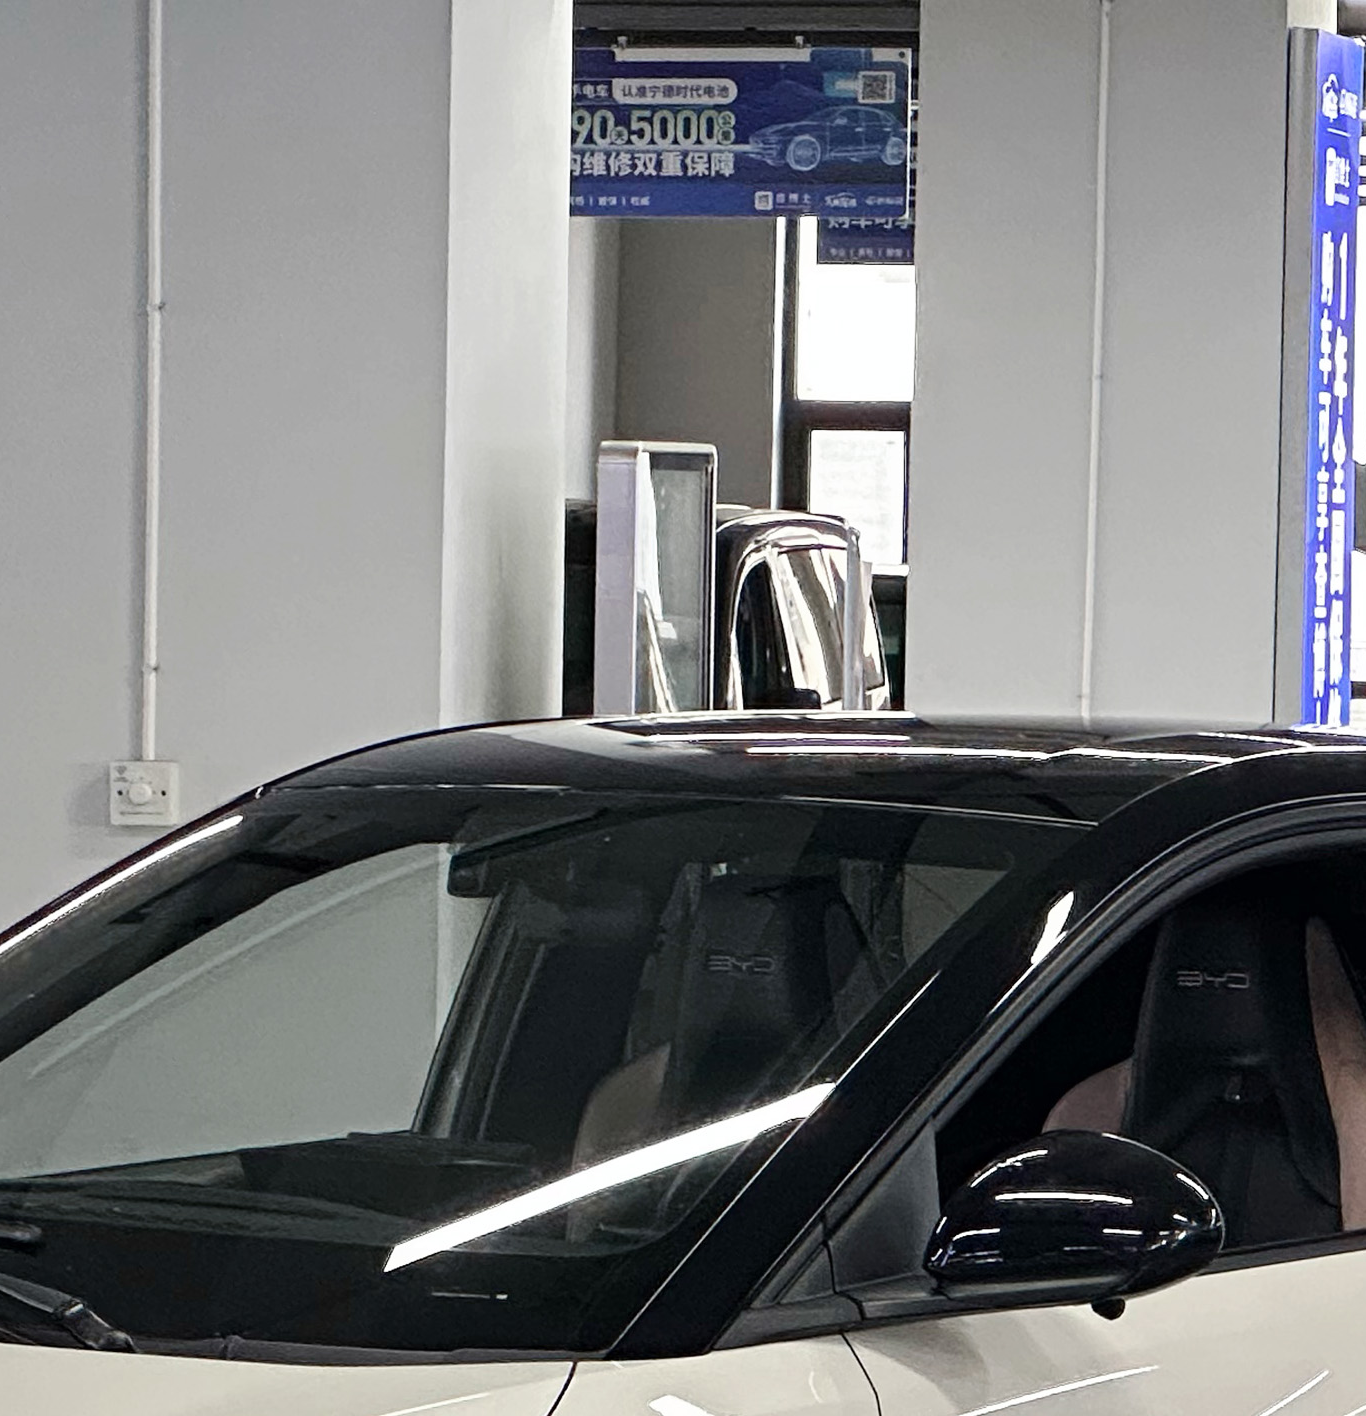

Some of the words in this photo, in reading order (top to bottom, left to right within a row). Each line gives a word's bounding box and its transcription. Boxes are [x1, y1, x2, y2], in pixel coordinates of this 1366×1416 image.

[622, 85, 729, 98] 认准宁德时代电池
[708, 955, 775, 974] BYD
[1177, 970, 1250, 990] BYD
